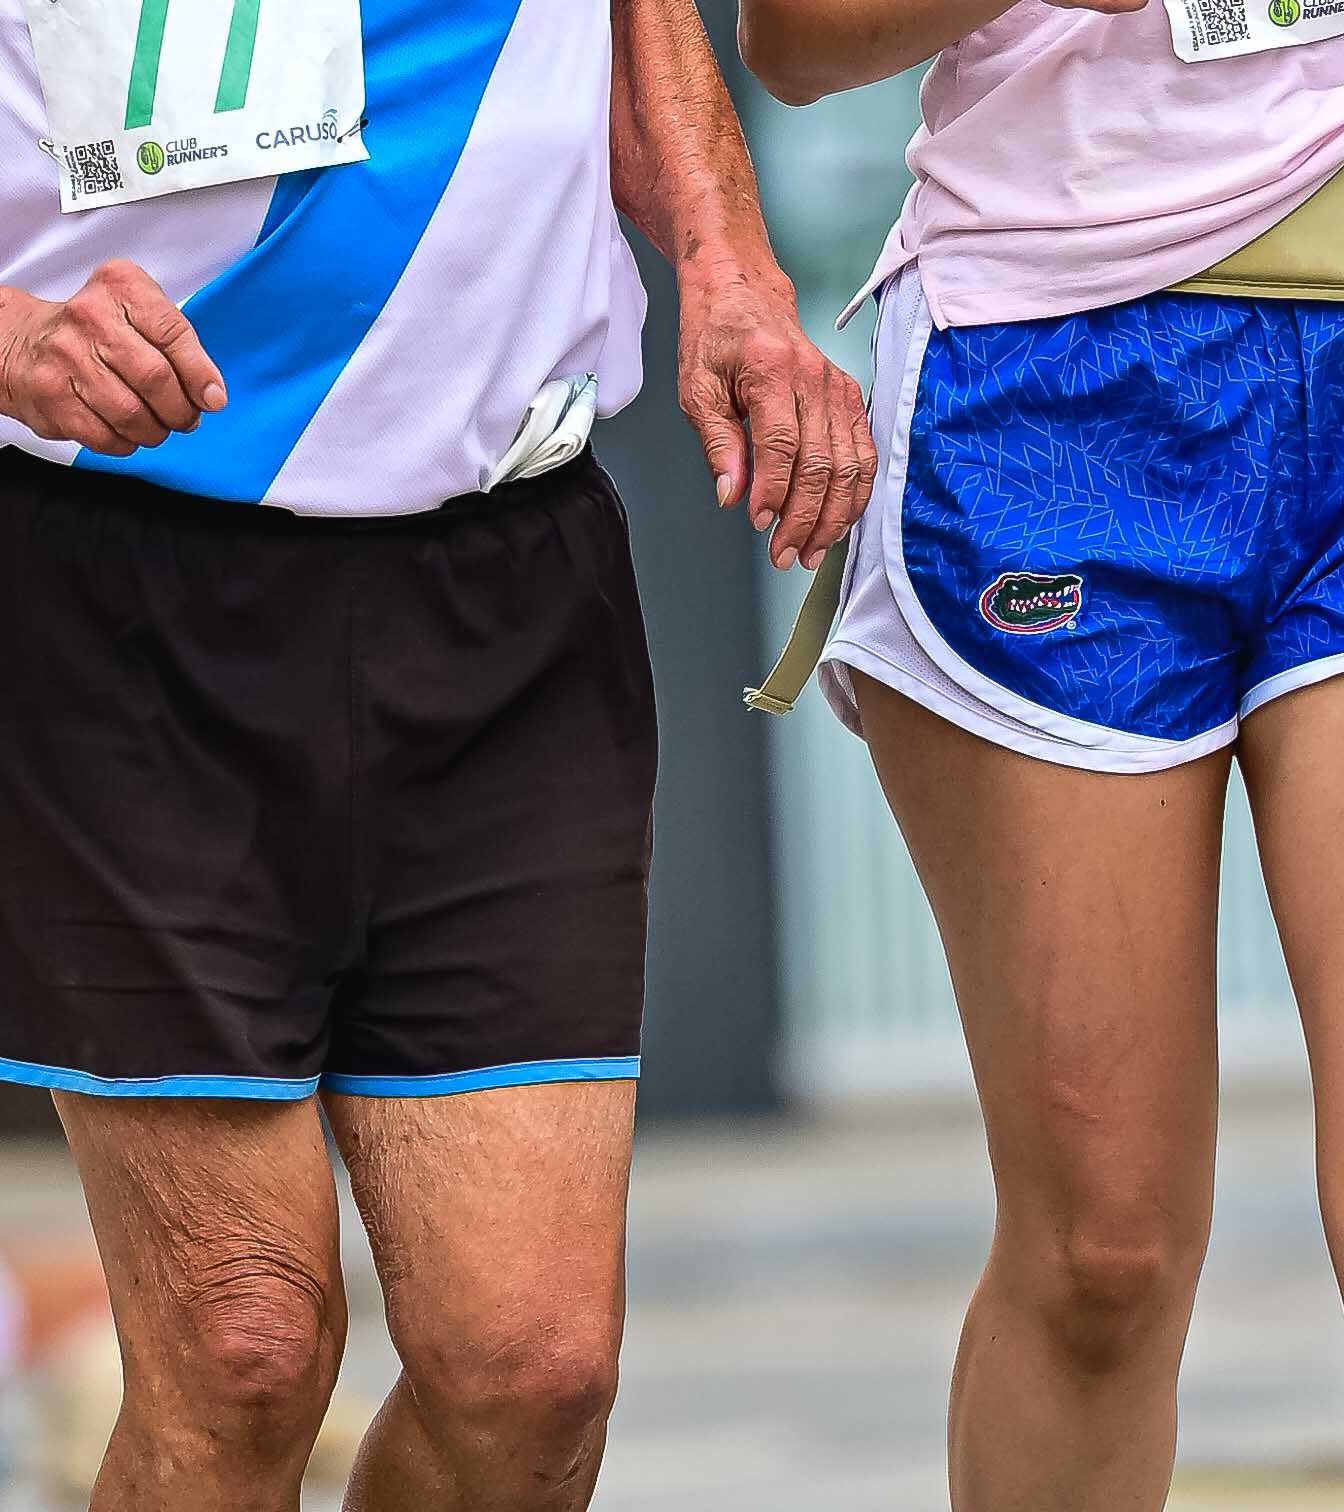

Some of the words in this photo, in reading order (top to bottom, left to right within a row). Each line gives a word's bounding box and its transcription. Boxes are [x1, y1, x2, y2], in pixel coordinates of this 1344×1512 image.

[166, 137, 198, 154] CLUB
[256, 122, 338, 150] CARUSO
[167, 145, 228, 166] RUNNER'S
